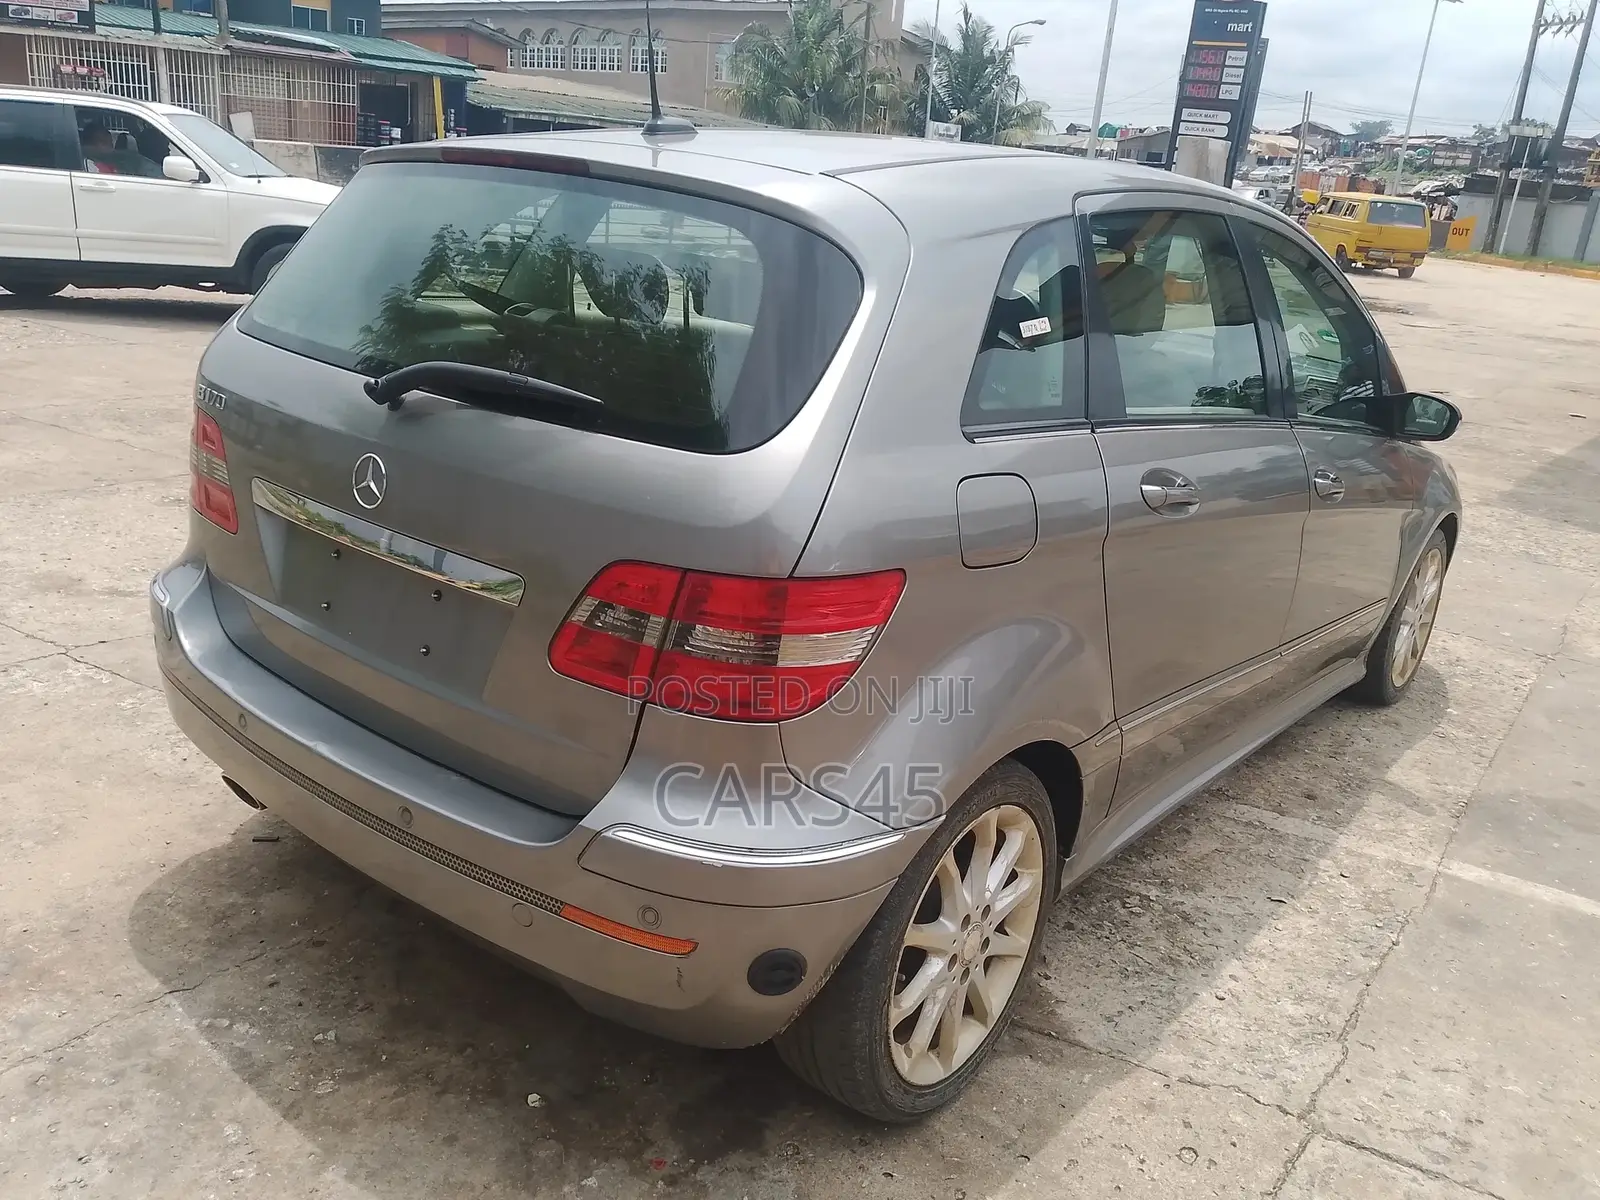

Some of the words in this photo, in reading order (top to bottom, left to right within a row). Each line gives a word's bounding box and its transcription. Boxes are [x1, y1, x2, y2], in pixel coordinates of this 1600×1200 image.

[1227, 21, 1253, 33] mart
[1227, 55, 1246, 63] Petrol
[1451, 226, 1471, 237] OUT
[197, 383, 227, 411] B170
